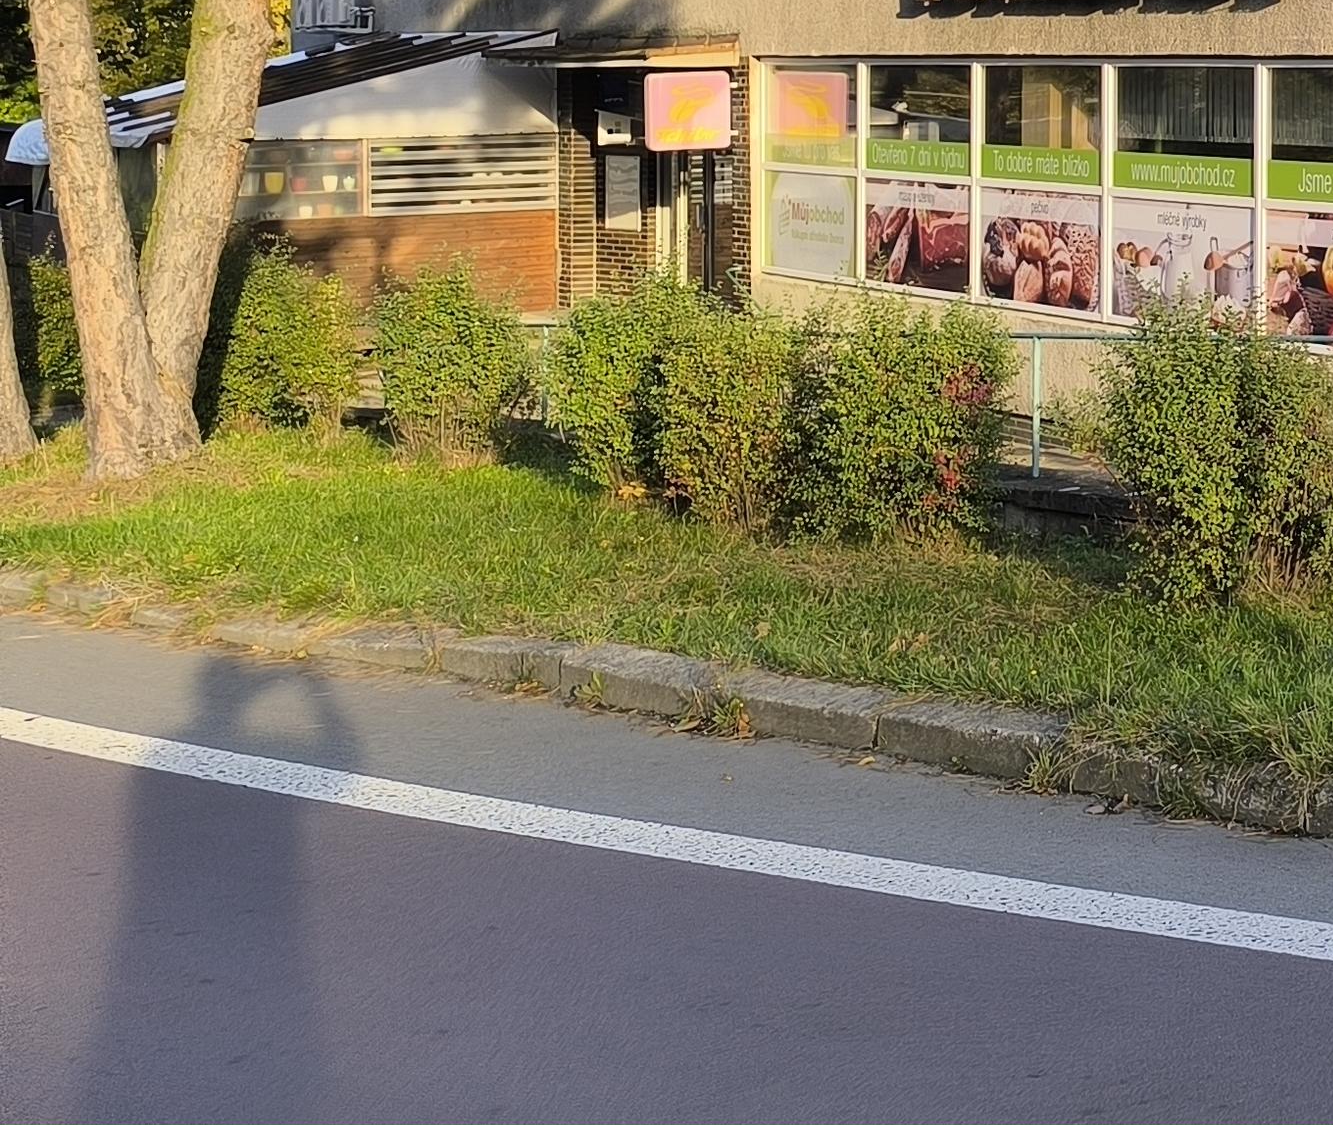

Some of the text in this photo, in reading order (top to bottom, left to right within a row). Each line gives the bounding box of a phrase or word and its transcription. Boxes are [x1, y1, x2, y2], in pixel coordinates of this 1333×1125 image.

[872, 143, 907, 165] Otevřeno
[911, 145, 916, 162] 7
[919, 146, 932, 167] dní
[941, 148, 966, 171] týdnu
[993, 150, 1090, 177] To dobré máte blízko
[1131, 161, 1236, 188] www.mujobchod.cz
[1298, 168, 1332, 194] Jsme
[1157, 212, 1207, 231] mléčné výrobky
